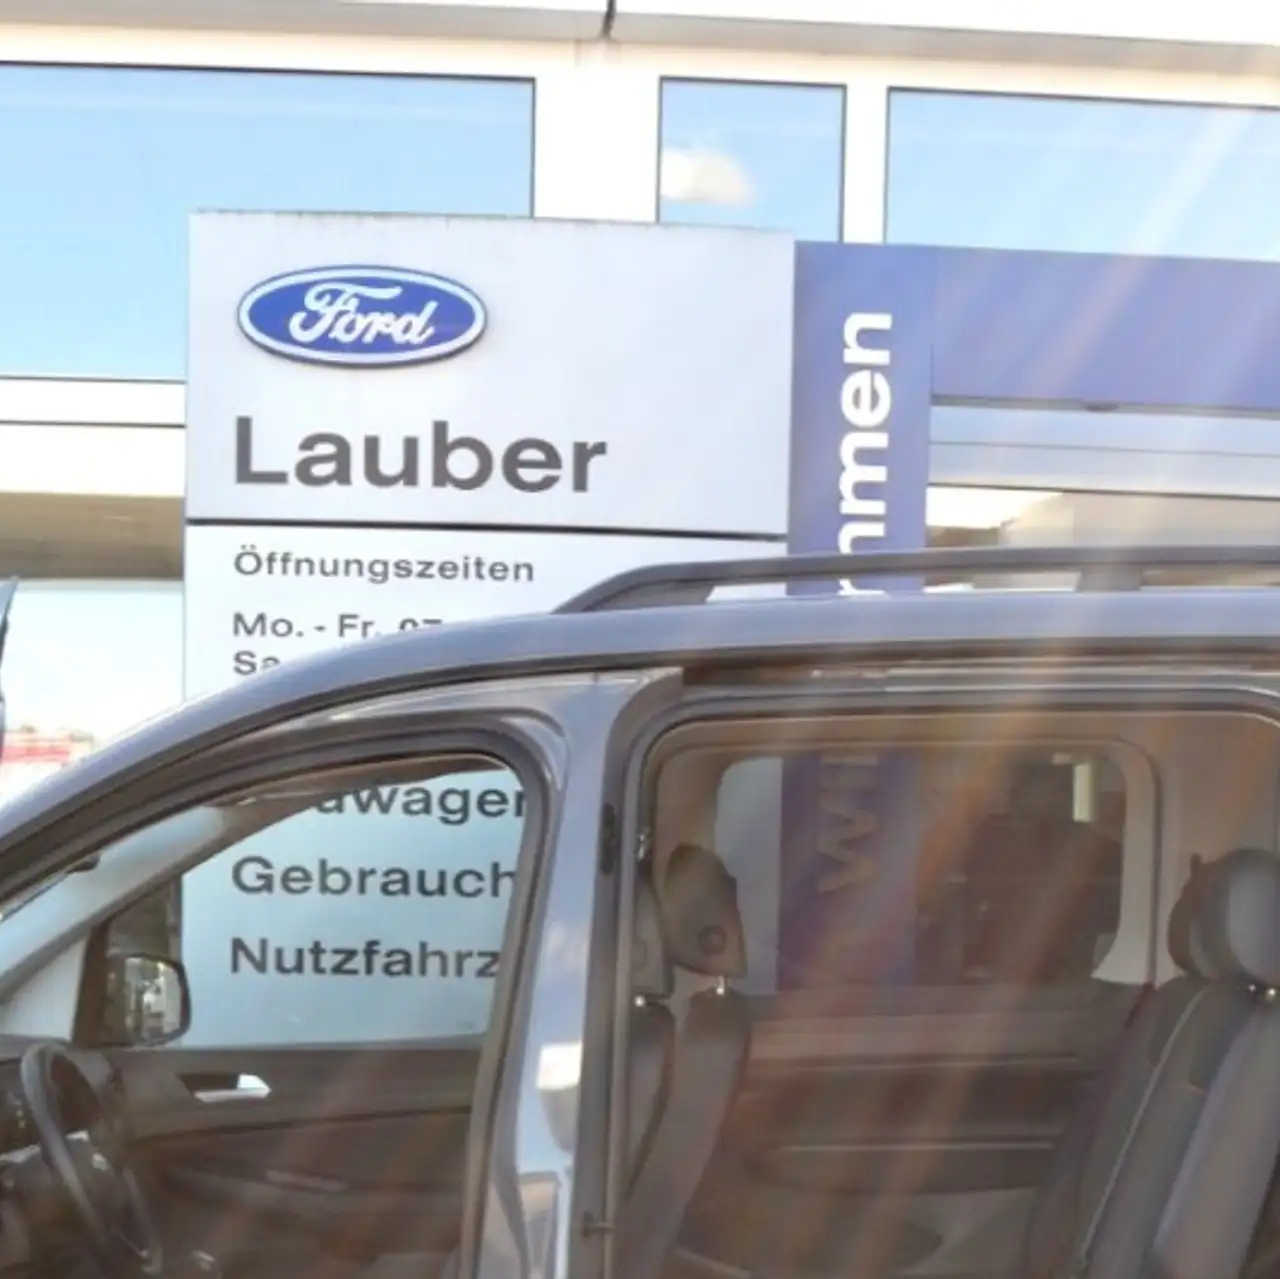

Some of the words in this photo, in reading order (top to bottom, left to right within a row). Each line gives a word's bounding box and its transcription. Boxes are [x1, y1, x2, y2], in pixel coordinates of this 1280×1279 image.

[289, 281, 439, 345] Ford
[235, 415, 608, 494] Lauber
[233, 544, 534, 584] Öffnungszeiten
[232, 611, 304, 638] Mo.
[230, 937, 500, 978] Nutzfahrz
